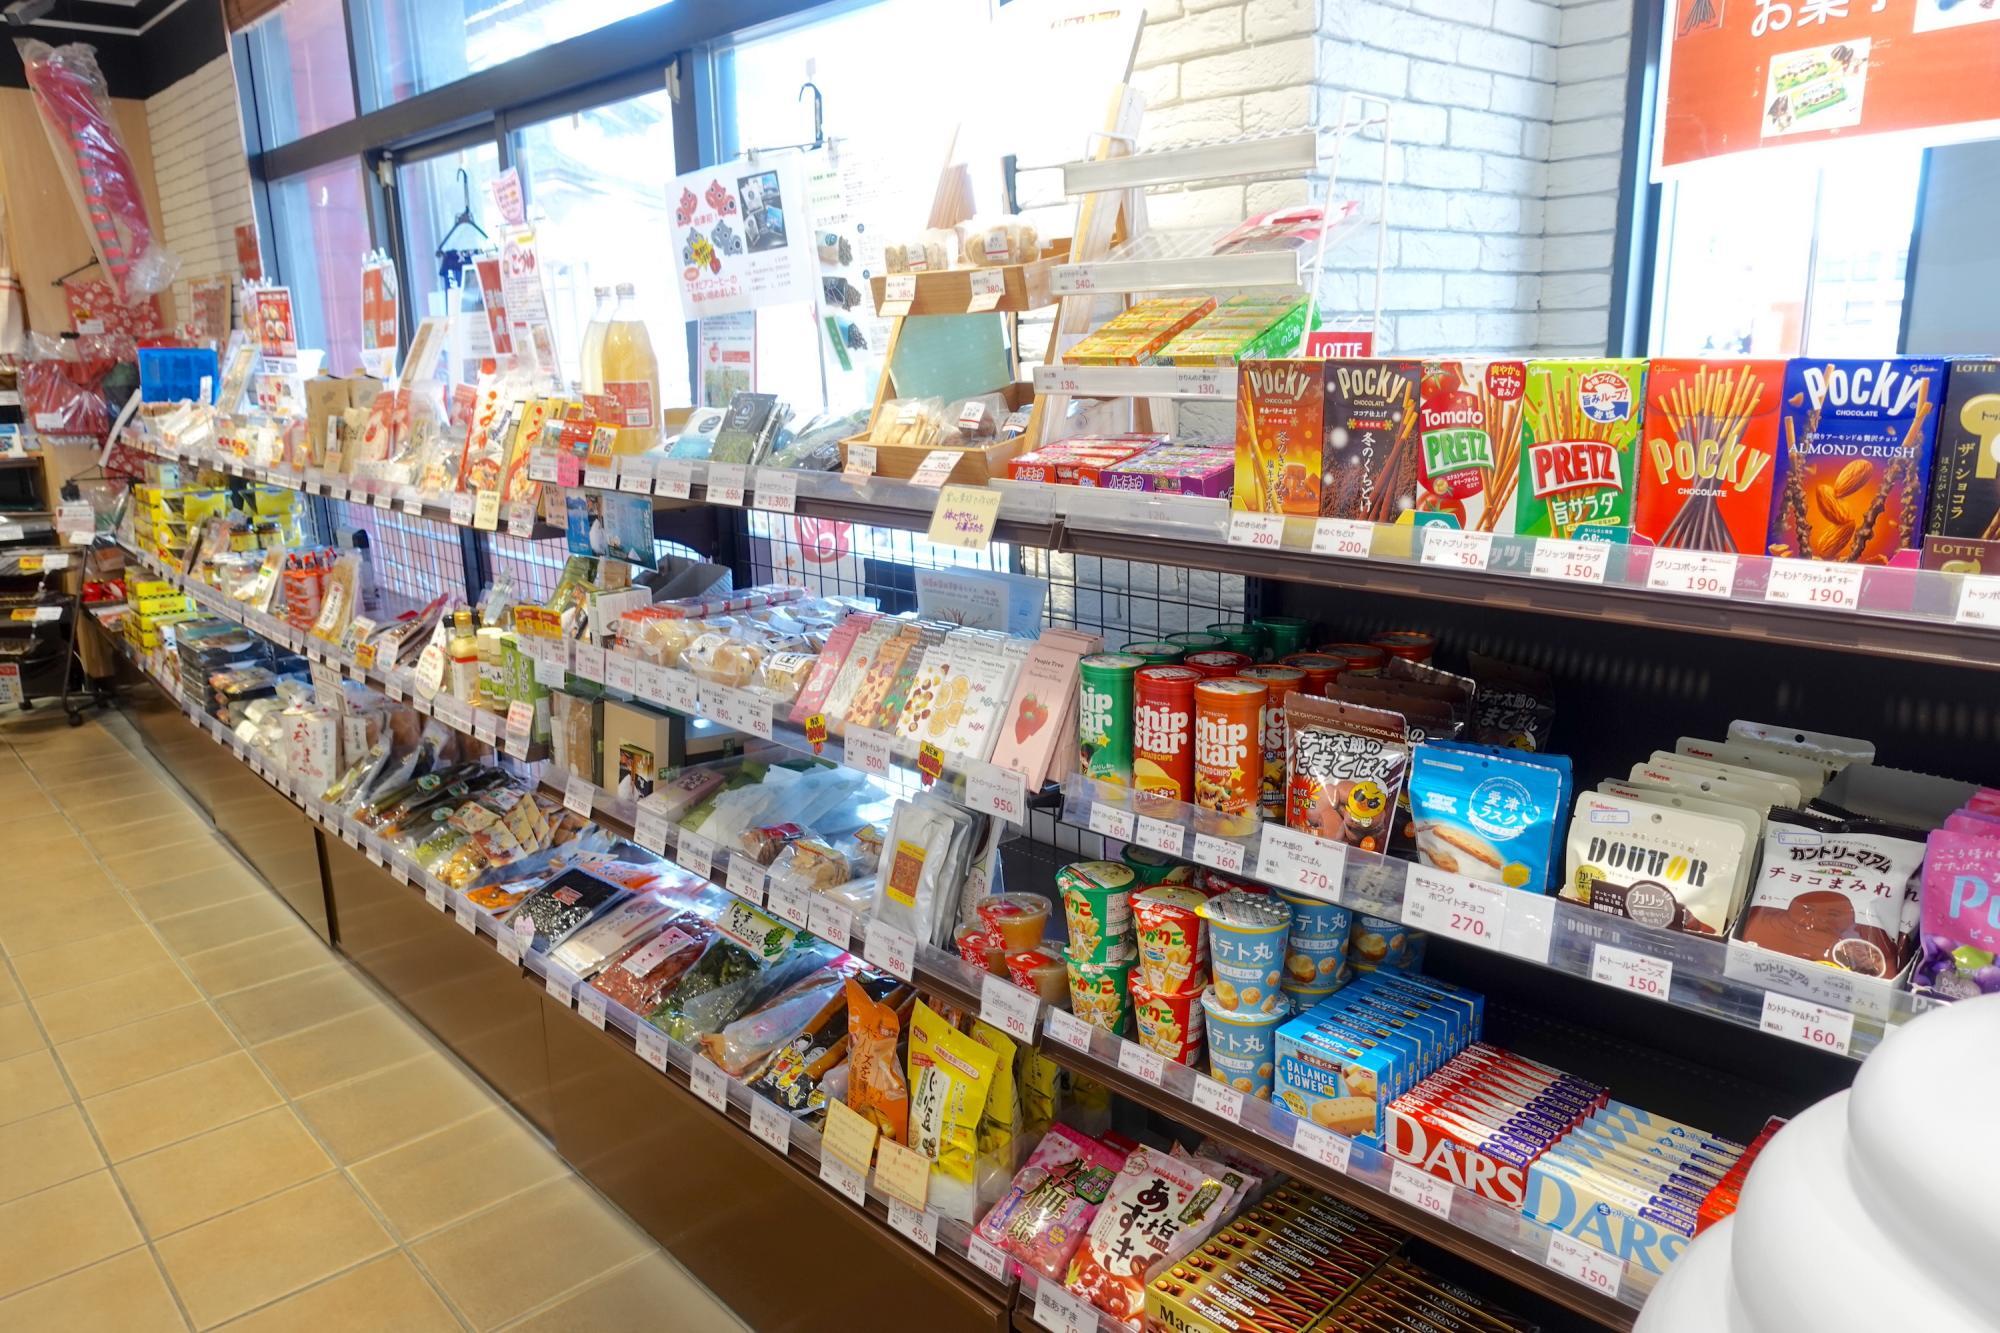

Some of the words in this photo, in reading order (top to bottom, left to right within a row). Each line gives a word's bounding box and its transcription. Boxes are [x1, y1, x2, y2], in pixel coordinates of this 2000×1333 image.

[1315, 342, 1363, 357] LOTTE
[1955, 363, 1996, 373] LOTTE
[1490, 376, 1521, 388] トマトの
[1422, 408, 1484, 428] Tomato
[1836, 409, 1879, 417] CHOCOLATE
[1425, 430, 1490, 469] PRETZ
[1789, 443, 1858, 456] ALMOND
[1861, 444, 1915, 459] CRUSH
[1361, 432, 1376, 513] 冬のくちどけ
[1534, 443, 1616, 489] PRETZ
[1677, 487, 1727, 498] CHOCOLATE
[1552, 491, 1618, 526] 旨サラダ
[1454, 551, 1484, 566] 50円
[1932, 543, 1985, 557] LOTTE
[1564, 564, 1601, 580] 150円
[1655, 560, 1717, 573] グリコポッキー
[1686, 576, 1727, 594] 190円
[1808, 588, 1853, 605] 190円
[1080, 687, 1113, 713] hip
[1301, 731, 1382, 754] チャ太郎の
[1294, 752, 1391, 779] たまごぱん
[1479, 806, 1517, 825] ラスク
[1587, 836, 1708, 887] DOUTOR
[1790, 846, 1893, 875] カントリーマアム
[1298, 869, 1335, 891] 270円
[1769, 865, 1893, 898] チョコまみれ
[1428, 893, 1486, 914] ホワイトチョコ
[1296, 911, 1348, 930] テト丸
[1450, 913, 1491, 939] 270円
[1599, 956, 1665, 979] ドトールビーンズ
[1628, 974, 1665, 997] 150円
[1207, 1028, 1265, 1053] テト丸
[1801, 1025, 1845, 1050] 160円
[1286, 1059, 1335, 1087] BALANCE
[1287, 1074, 1325, 1094] POWER
[1392, 1101, 1416, 1114] DARS
[1385, 1109, 1525, 1206] DARS
[1416, 1193, 1447, 1216] 150円
[1552, 1239, 1592, 1265] 白いダース
[1253, 1248, 1301, 1280] Macadamia
[1237, 1260, 1286, 1292] Macadamia
[1580, 1264, 1615, 1292] 150円
[1221, 1272, 1271, 1305] Macadamia
[1205, 1284, 1256, 1317] Macadamia
[1189, 1297, 1240, 1331] Macadamia
[1415, 1304, 1460, 1330] ALMOND
